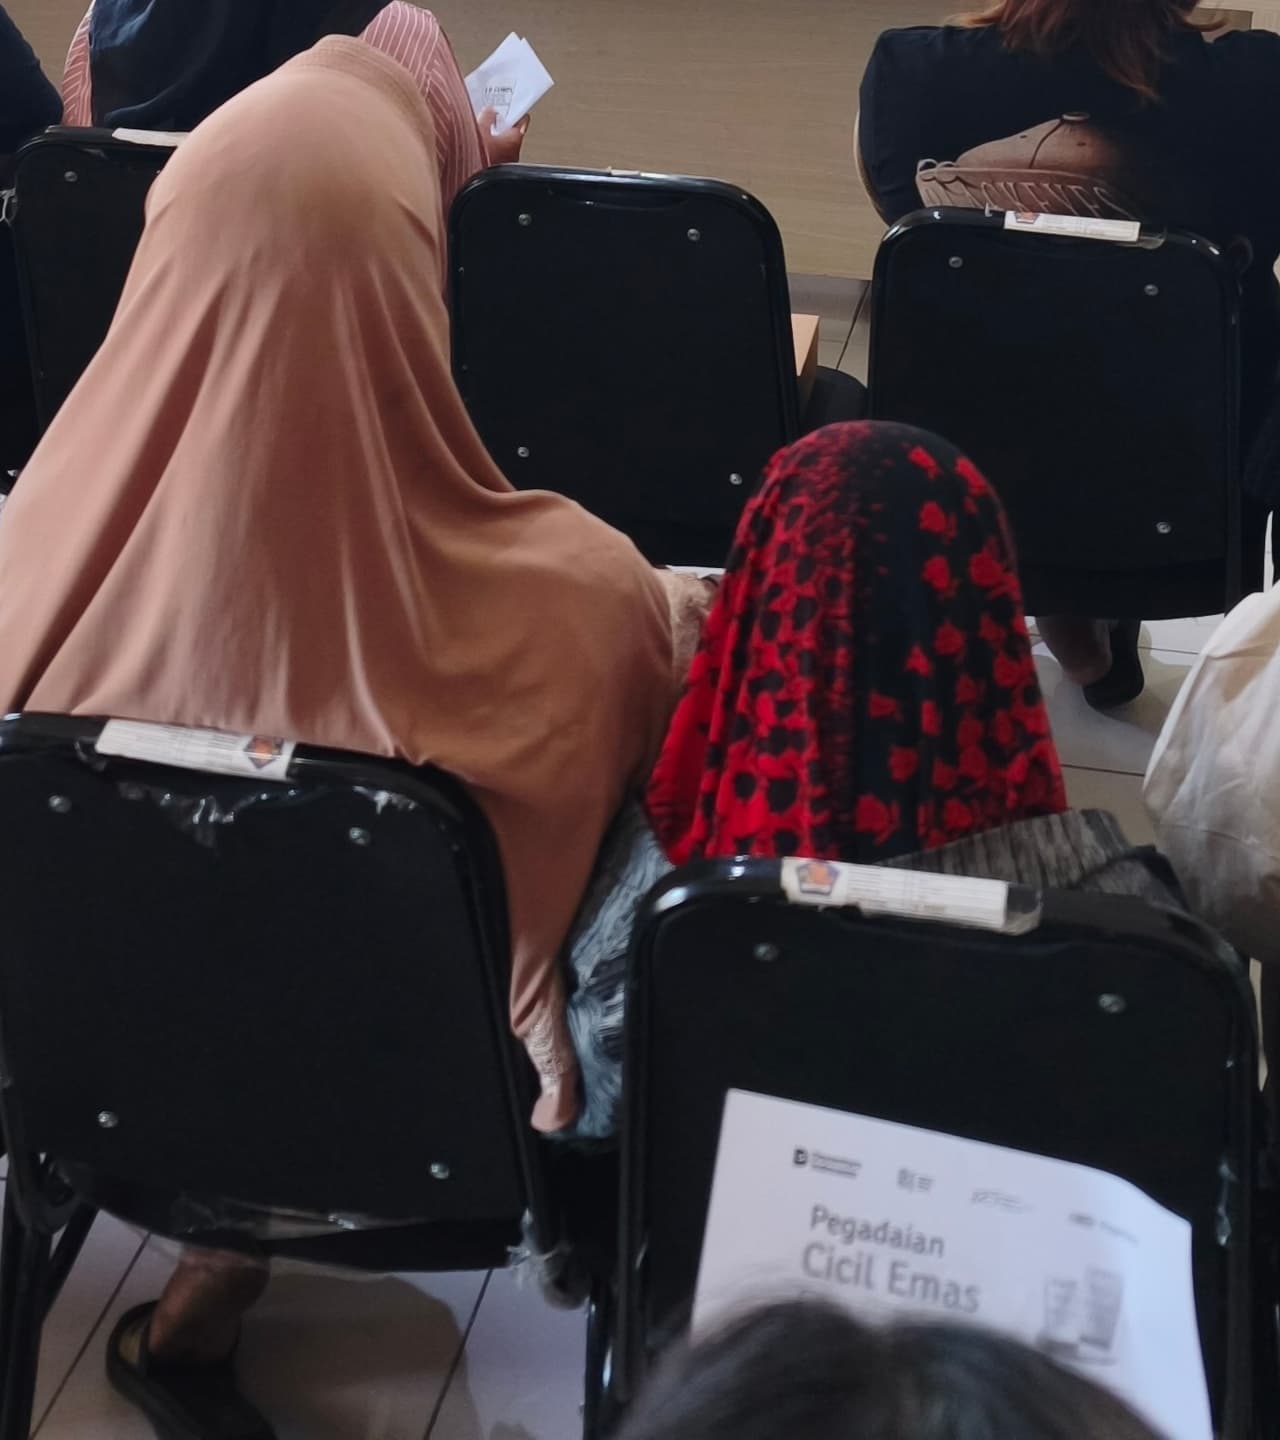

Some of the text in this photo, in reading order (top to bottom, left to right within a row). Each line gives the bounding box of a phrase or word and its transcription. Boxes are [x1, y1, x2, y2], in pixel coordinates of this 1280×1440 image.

[809, 1203, 946, 1259] Pegadaian
[801, 1240, 981, 1313] Cicil Emas
